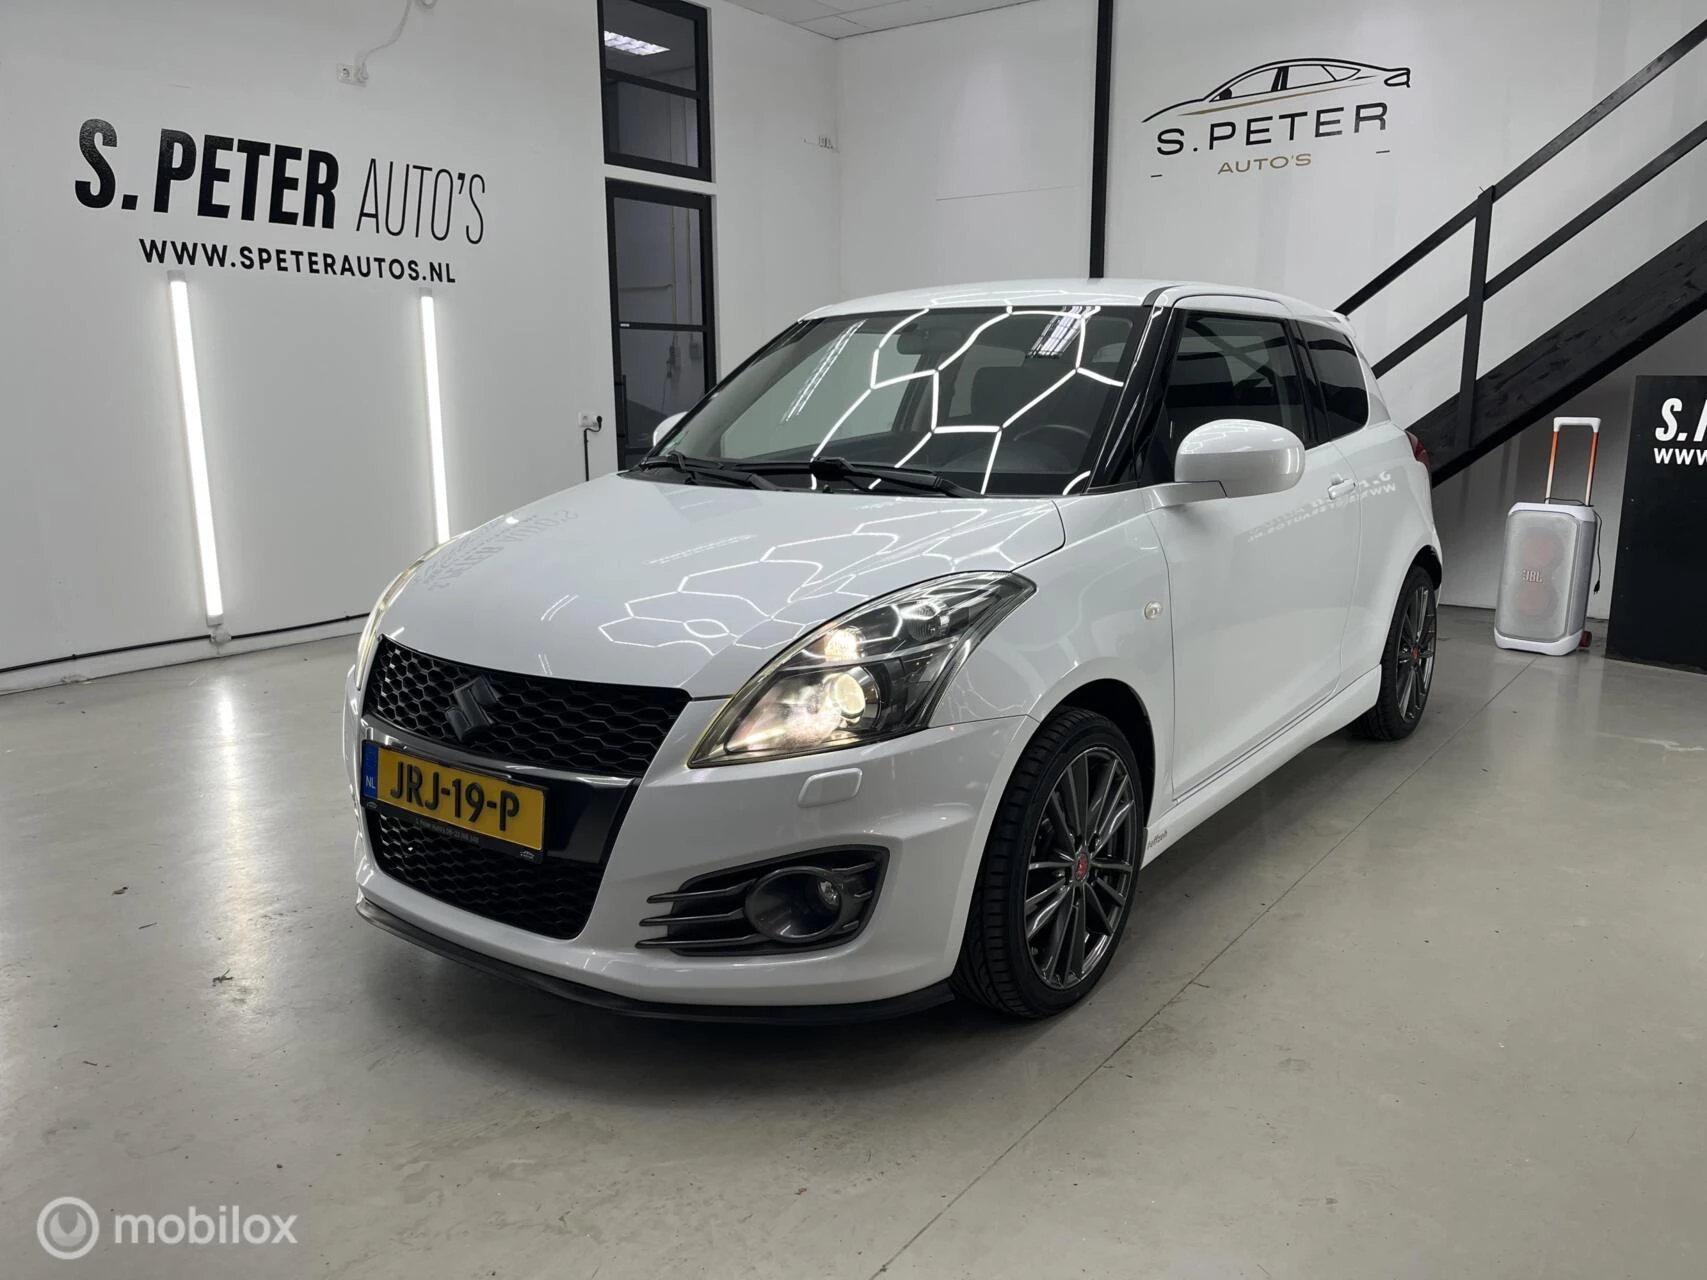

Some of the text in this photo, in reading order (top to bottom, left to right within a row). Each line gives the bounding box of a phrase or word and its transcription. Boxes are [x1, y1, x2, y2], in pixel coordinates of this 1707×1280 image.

[1217, 153, 1312, 175] AUTO'S
[153, 128, 339, 230] PETER
[355, 157, 486, 245] AUTO'S
[138, 238, 456, 284] WWW.SPETERAUTOS.NL
[1522, 569, 1544, 584] JBL
[365, 775, 377, 790] NL
[390, 761, 520, 832] JRJ-19-P
